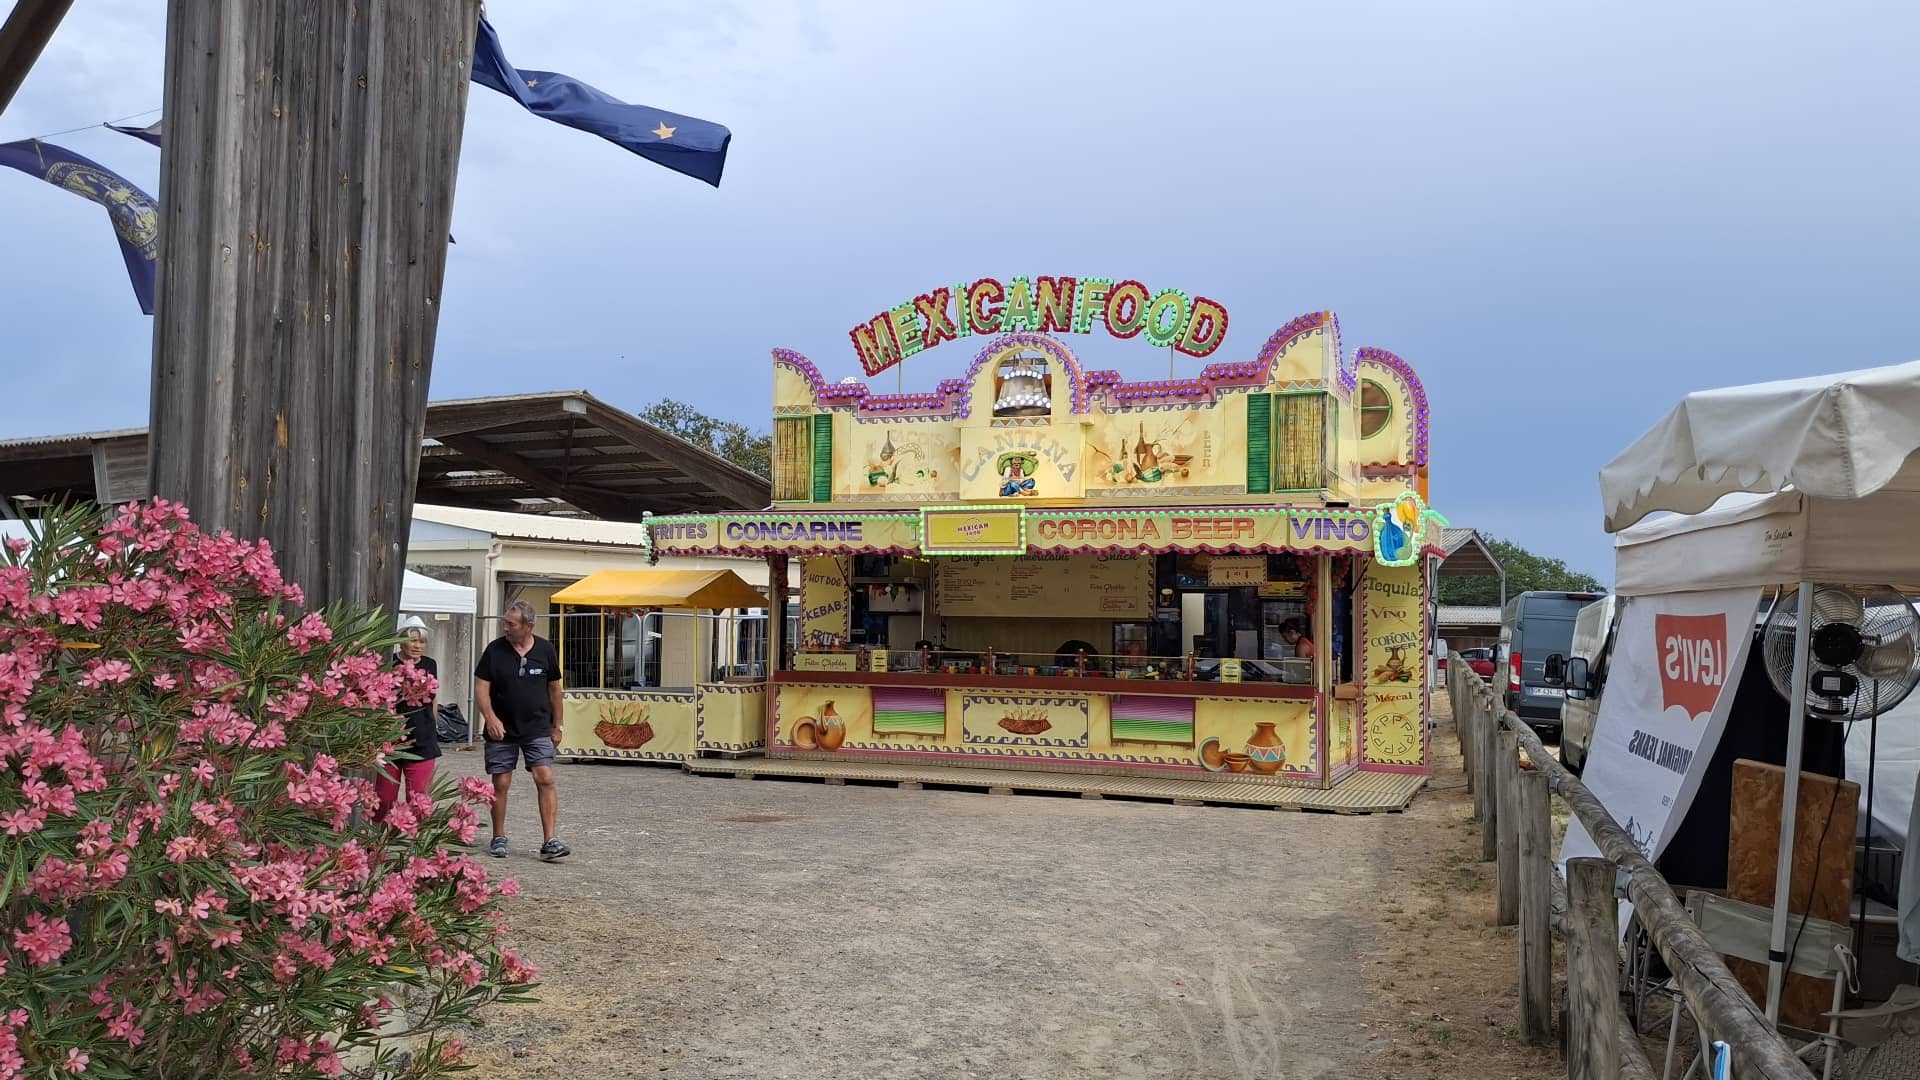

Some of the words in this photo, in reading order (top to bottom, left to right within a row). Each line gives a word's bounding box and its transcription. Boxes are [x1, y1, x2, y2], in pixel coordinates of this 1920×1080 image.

[961, 429, 1077, 482] CANTINA
[654, 523, 708, 540] FRITES
[726, 521, 863, 542] CONCARNE
[957, 522, 989, 532] MEXICAN
[1037, 518, 1160, 540] CORONA
[1170, 517, 1255, 539] BEER
[1290, 517, 1370, 541] VINO
[809, 573, 825, 584] HOT
[826, 576, 842, 588] DOG
[1368, 577, 1420, 597] Tequila
[806, 600, 842, 621] KEBAB
